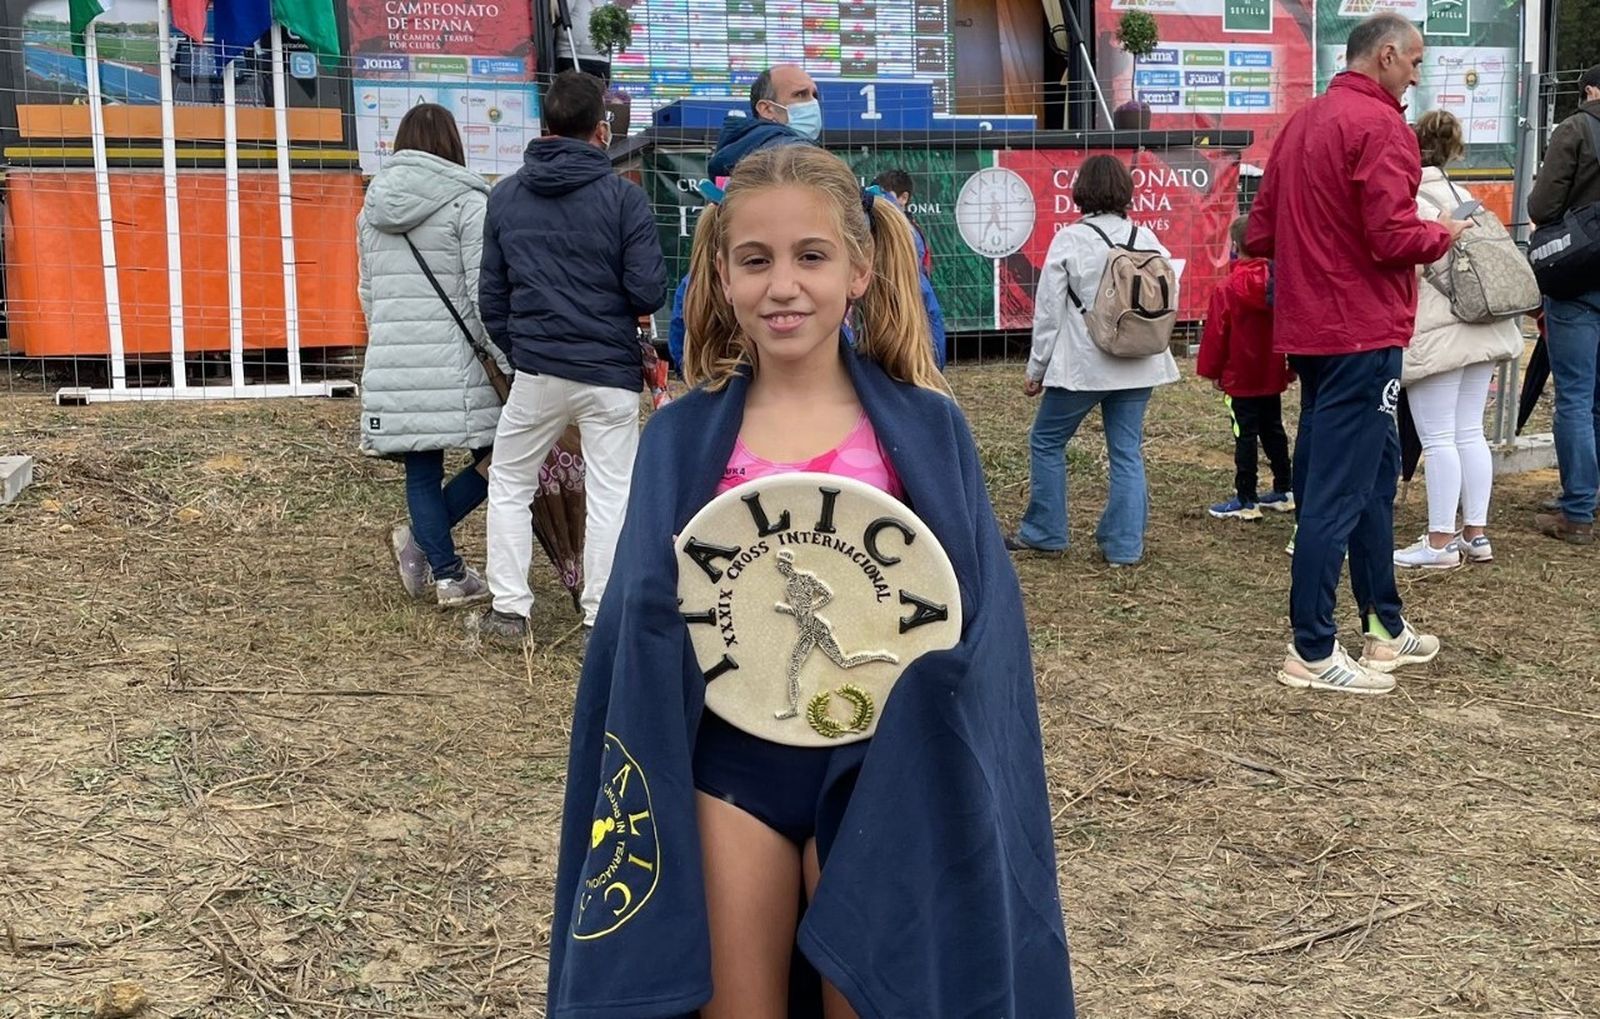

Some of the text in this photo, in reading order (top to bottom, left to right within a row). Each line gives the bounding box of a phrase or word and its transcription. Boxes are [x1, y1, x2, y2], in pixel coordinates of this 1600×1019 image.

[385, 1, 499, 17] CAMPEONATO
[1230, 7, 1266, 15] SEVILLA
[387, 17, 474, 32] DE ESPAÑA
[858, 84, 882, 120] 1
[1053, 168, 1209, 189] CAONATO
[718, 531, 891, 648] XXXIX CROSS INTERNACIONAL
